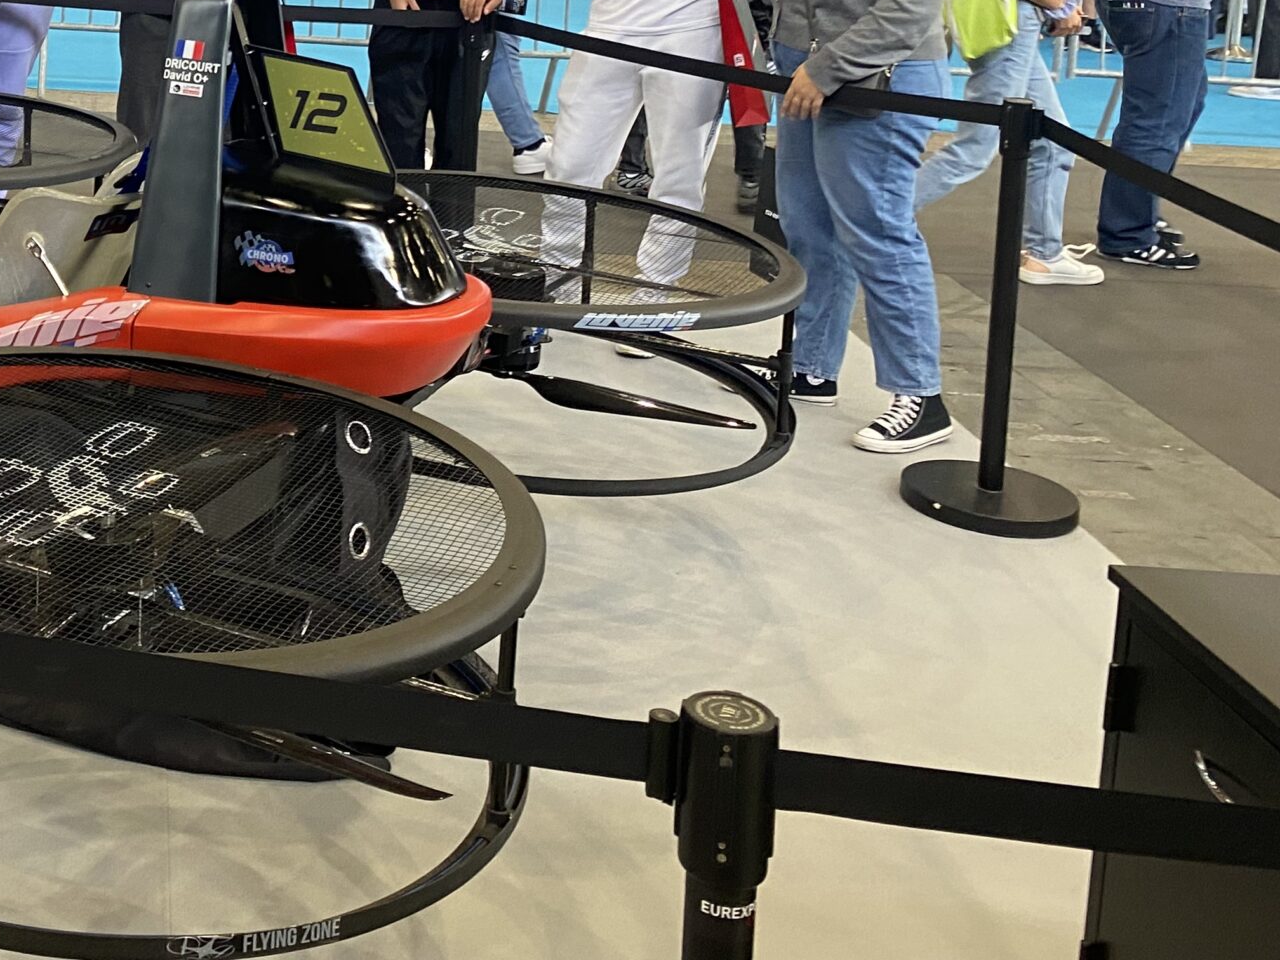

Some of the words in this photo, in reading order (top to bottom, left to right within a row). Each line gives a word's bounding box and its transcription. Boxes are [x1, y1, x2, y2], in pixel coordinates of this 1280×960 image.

[165, 58, 221, 74] DRICOURT
[163, 69, 192, 81] David
[193, 72, 209, 83] O+
[289, 90, 348, 134] 12
[247, 249, 289, 264] CHRONO
[242, 927, 297, 953] FLYING
[301, 916, 342, 943] ZONE
